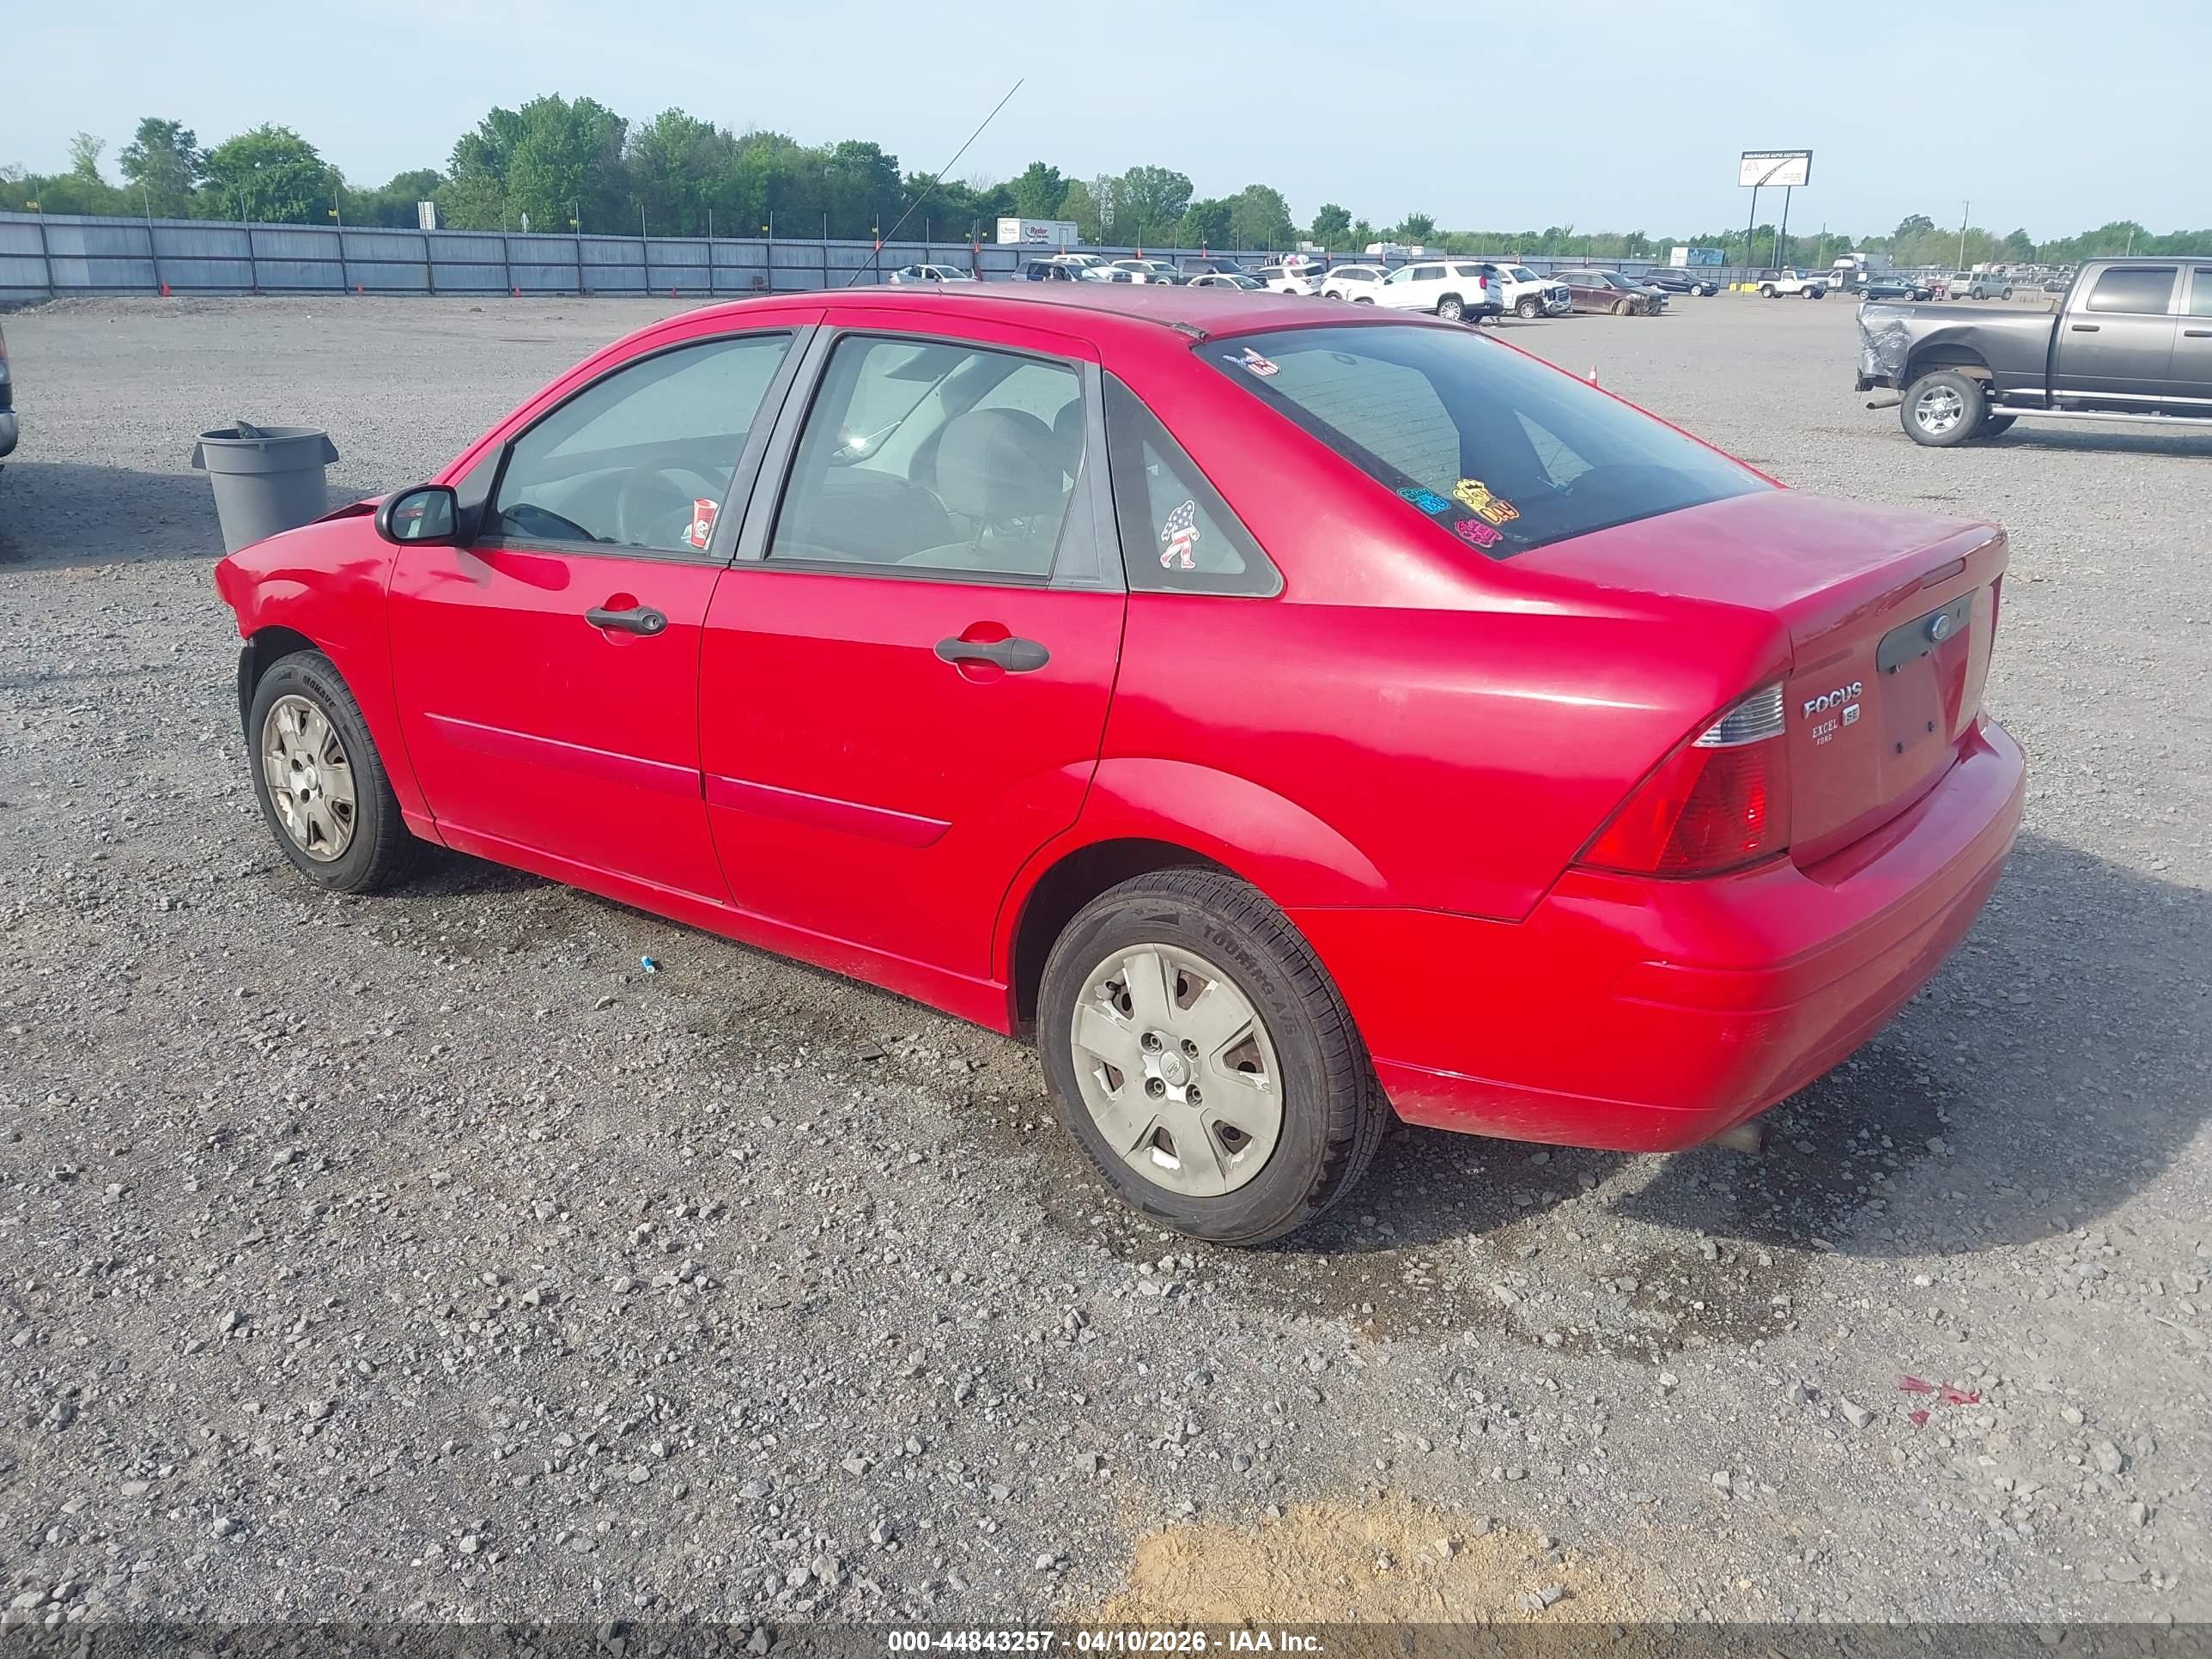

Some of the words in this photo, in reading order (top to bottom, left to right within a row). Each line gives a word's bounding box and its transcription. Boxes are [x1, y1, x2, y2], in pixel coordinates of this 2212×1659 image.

[1480, 501, 1517, 523] DAY
[302, 675, 337, 708] MOHAVE
[1802, 681, 1863, 720] FOCUS
[1846, 708, 1858, 721] SE
[1813, 719, 1838, 738] EXCEL
[1203, 926, 1276, 996] TOURING
